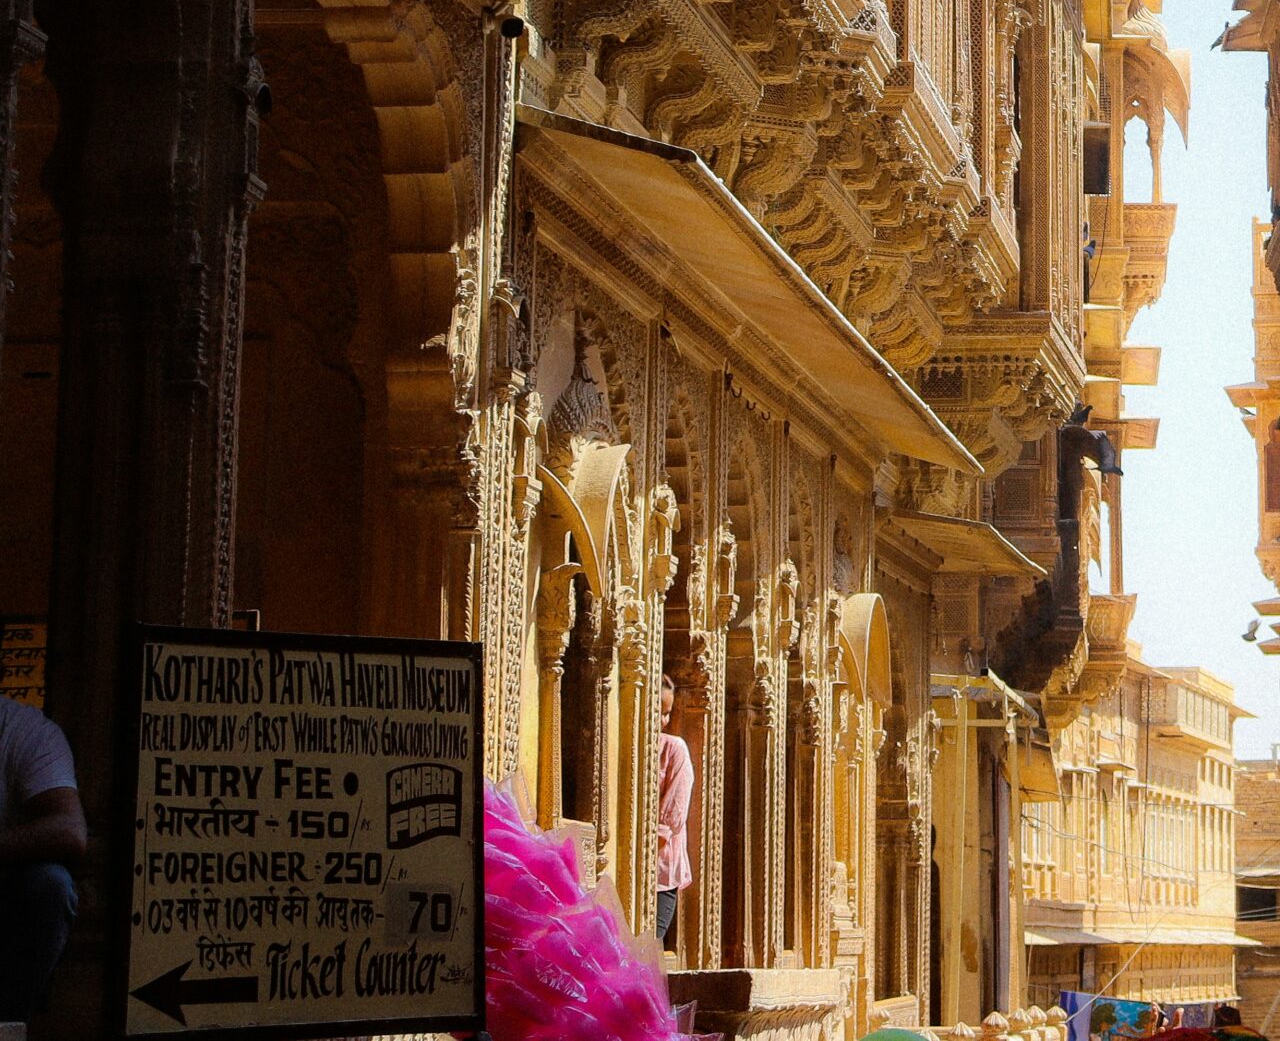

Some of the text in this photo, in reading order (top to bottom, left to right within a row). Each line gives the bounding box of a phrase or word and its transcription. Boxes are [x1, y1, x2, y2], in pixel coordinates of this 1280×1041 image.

[269, 651, 336, 706] PATWA
[340, 654, 398, 710] HAVELI
[401, 657, 471, 714] MUSEUM
[141, 712, 176, 752] REAL
[179, 713, 236, 753] DISPLAY
[238, 715, 253, 755] of
[254, 713, 289, 753] ERST
[291, 712, 338, 755] WHILE
[381, 716, 433, 758] GRACIOUS
[154, 758, 334, 800] ENTRY FEE
[390, 767, 454, 806] CAMERA
[154, 798, 259, 839] भारतीय
[389, 803, 456, 843] FREE
[148, 852, 312, 886] FOREIGNER
[148, 898, 174, 934] 03
[224, 896, 248, 931] 10
[266, 937, 447, 1002] Ticket Counter
